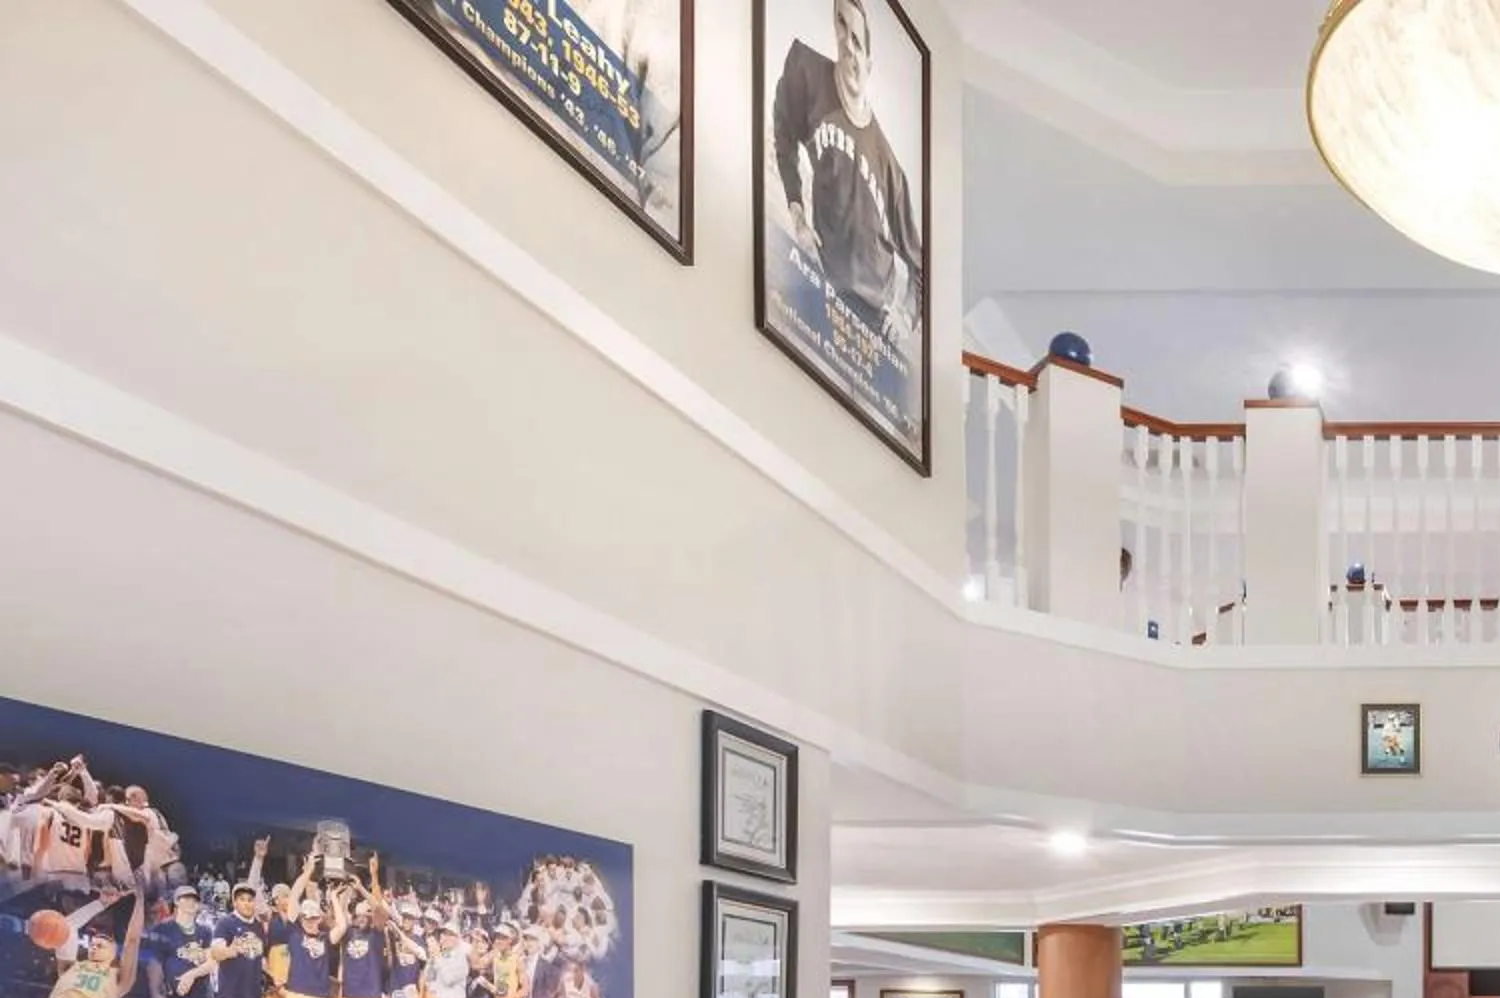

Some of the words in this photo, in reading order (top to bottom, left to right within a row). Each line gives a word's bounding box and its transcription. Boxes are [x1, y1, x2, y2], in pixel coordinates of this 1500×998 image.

[462, 1, 555, 99] Champions
[503, 7, 582, 96] 87-11-9
[546, 0, 631, 94] Leahy
[562, 39, 640, 129] 1946-53
[60, 822, 81, 848] 32
